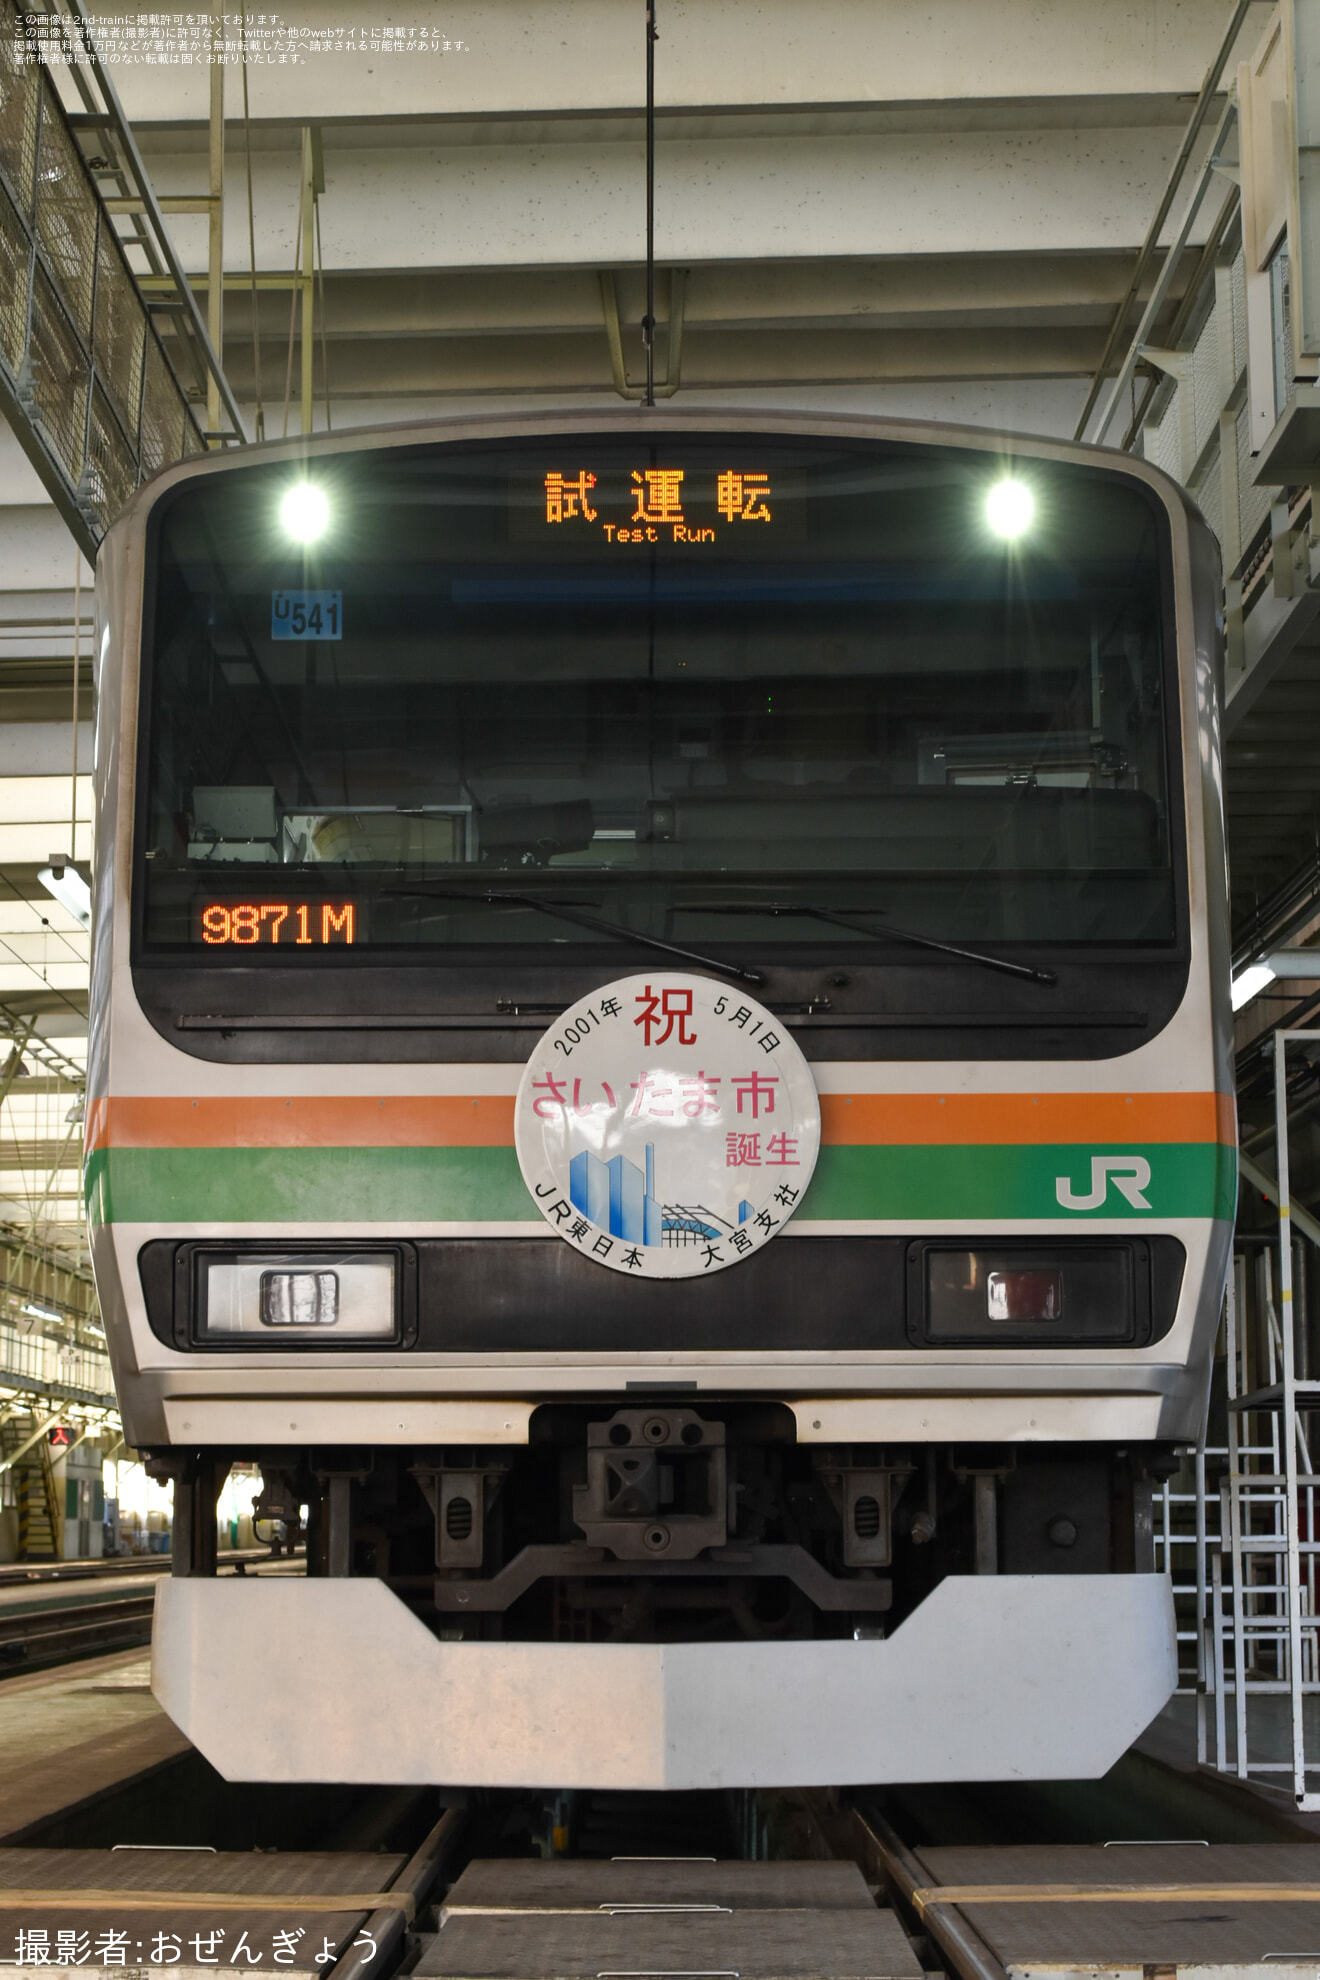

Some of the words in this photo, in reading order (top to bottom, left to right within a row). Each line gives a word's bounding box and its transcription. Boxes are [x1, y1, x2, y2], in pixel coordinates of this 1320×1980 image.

[544, 470, 771, 522] 試運転
[603, 524, 658, 543] Test
[673, 524, 715, 542] Run
[203, 904, 353, 944] 9871M
[553, 996, 623, 1057] 2001年
[633, 984, 697, 1046] 祝
[713, 995, 781, 1054] 5月1日
[532, 1070, 780, 1119] さいたま市
[725, 1131, 801, 1167] 誕生
[1056, 1157, 1152, 1210] JR
[535, 1183, 645, 1269] JR東日本
[700, 1183, 800, 1268] 大宮支社
[23, 1319, 35, 1335] 7
